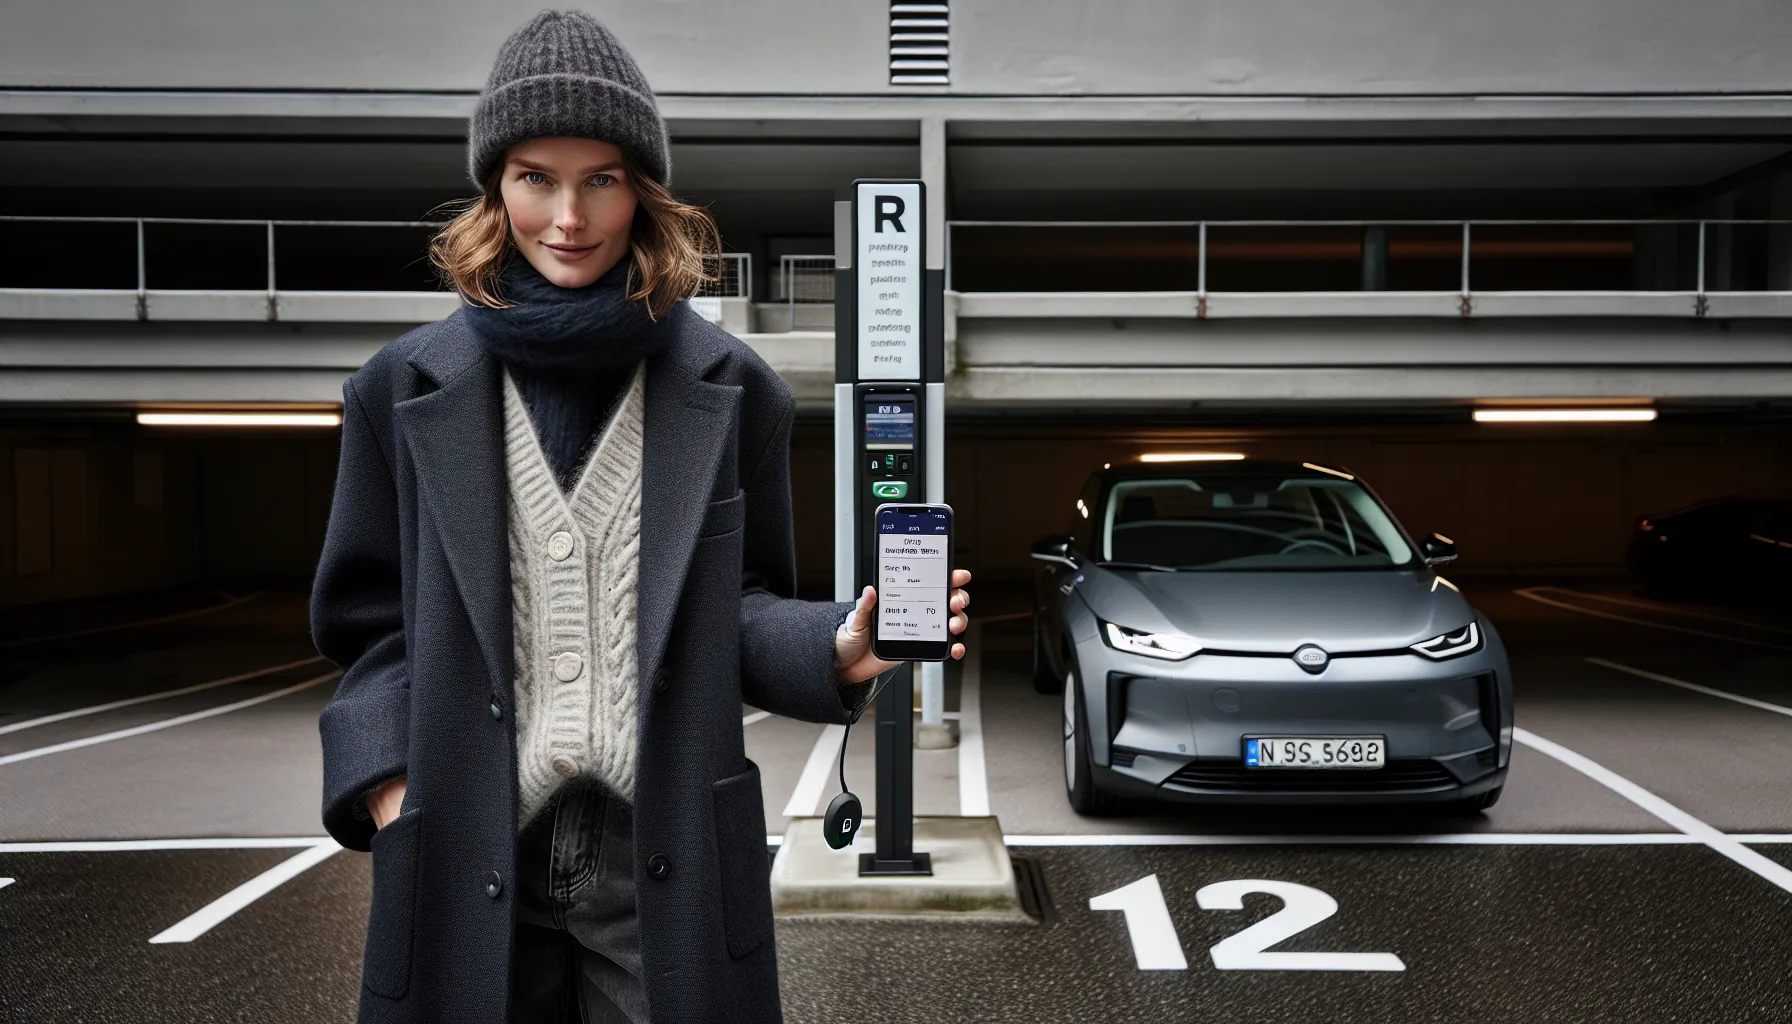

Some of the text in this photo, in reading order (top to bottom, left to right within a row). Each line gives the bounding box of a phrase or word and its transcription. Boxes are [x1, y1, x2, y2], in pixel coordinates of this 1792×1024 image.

[875, 195, 906, 233] R
[1261, 741, 1274, 763] N
[1089, 873, 1406, 971] 12
